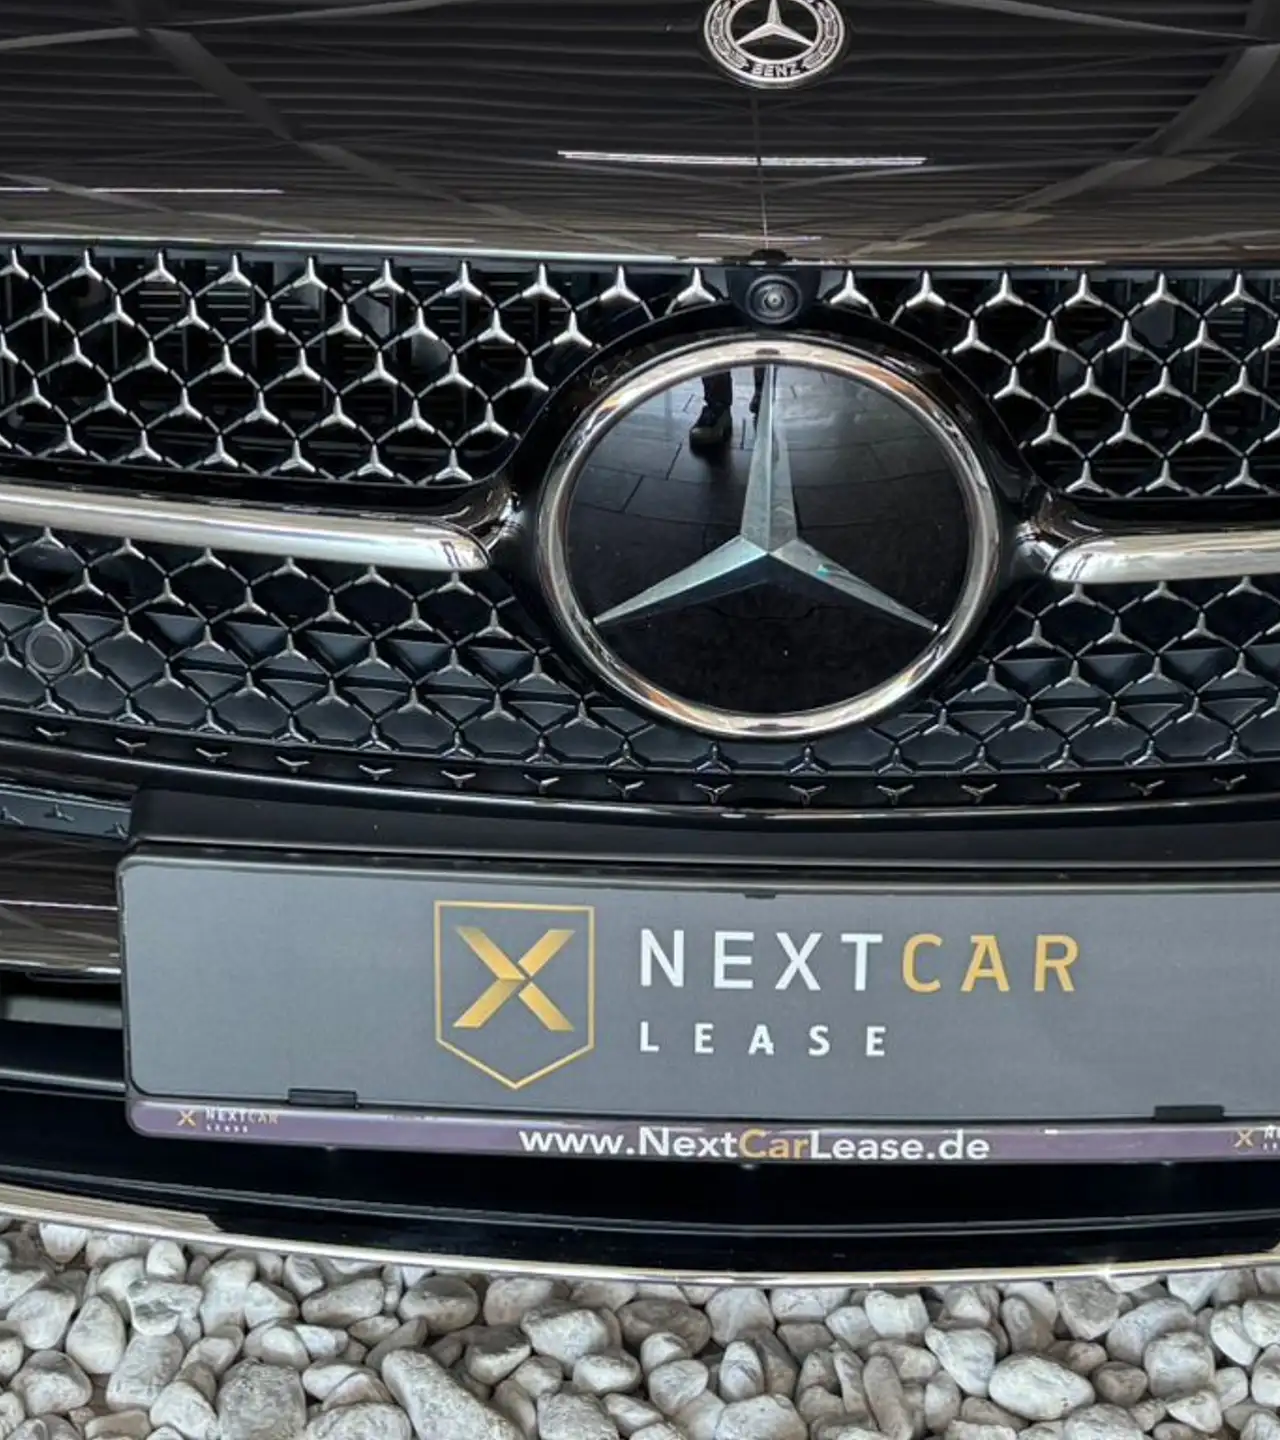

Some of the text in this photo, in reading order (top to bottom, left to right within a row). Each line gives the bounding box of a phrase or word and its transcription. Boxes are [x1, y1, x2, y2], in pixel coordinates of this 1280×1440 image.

[751, 63, 801, 78] BENZ
[639, 928, 1079, 993] NEXTCAR
[639, 1020, 887, 1057] LEASE
[519, 1126, 990, 1161] www.NextCarLease.de
